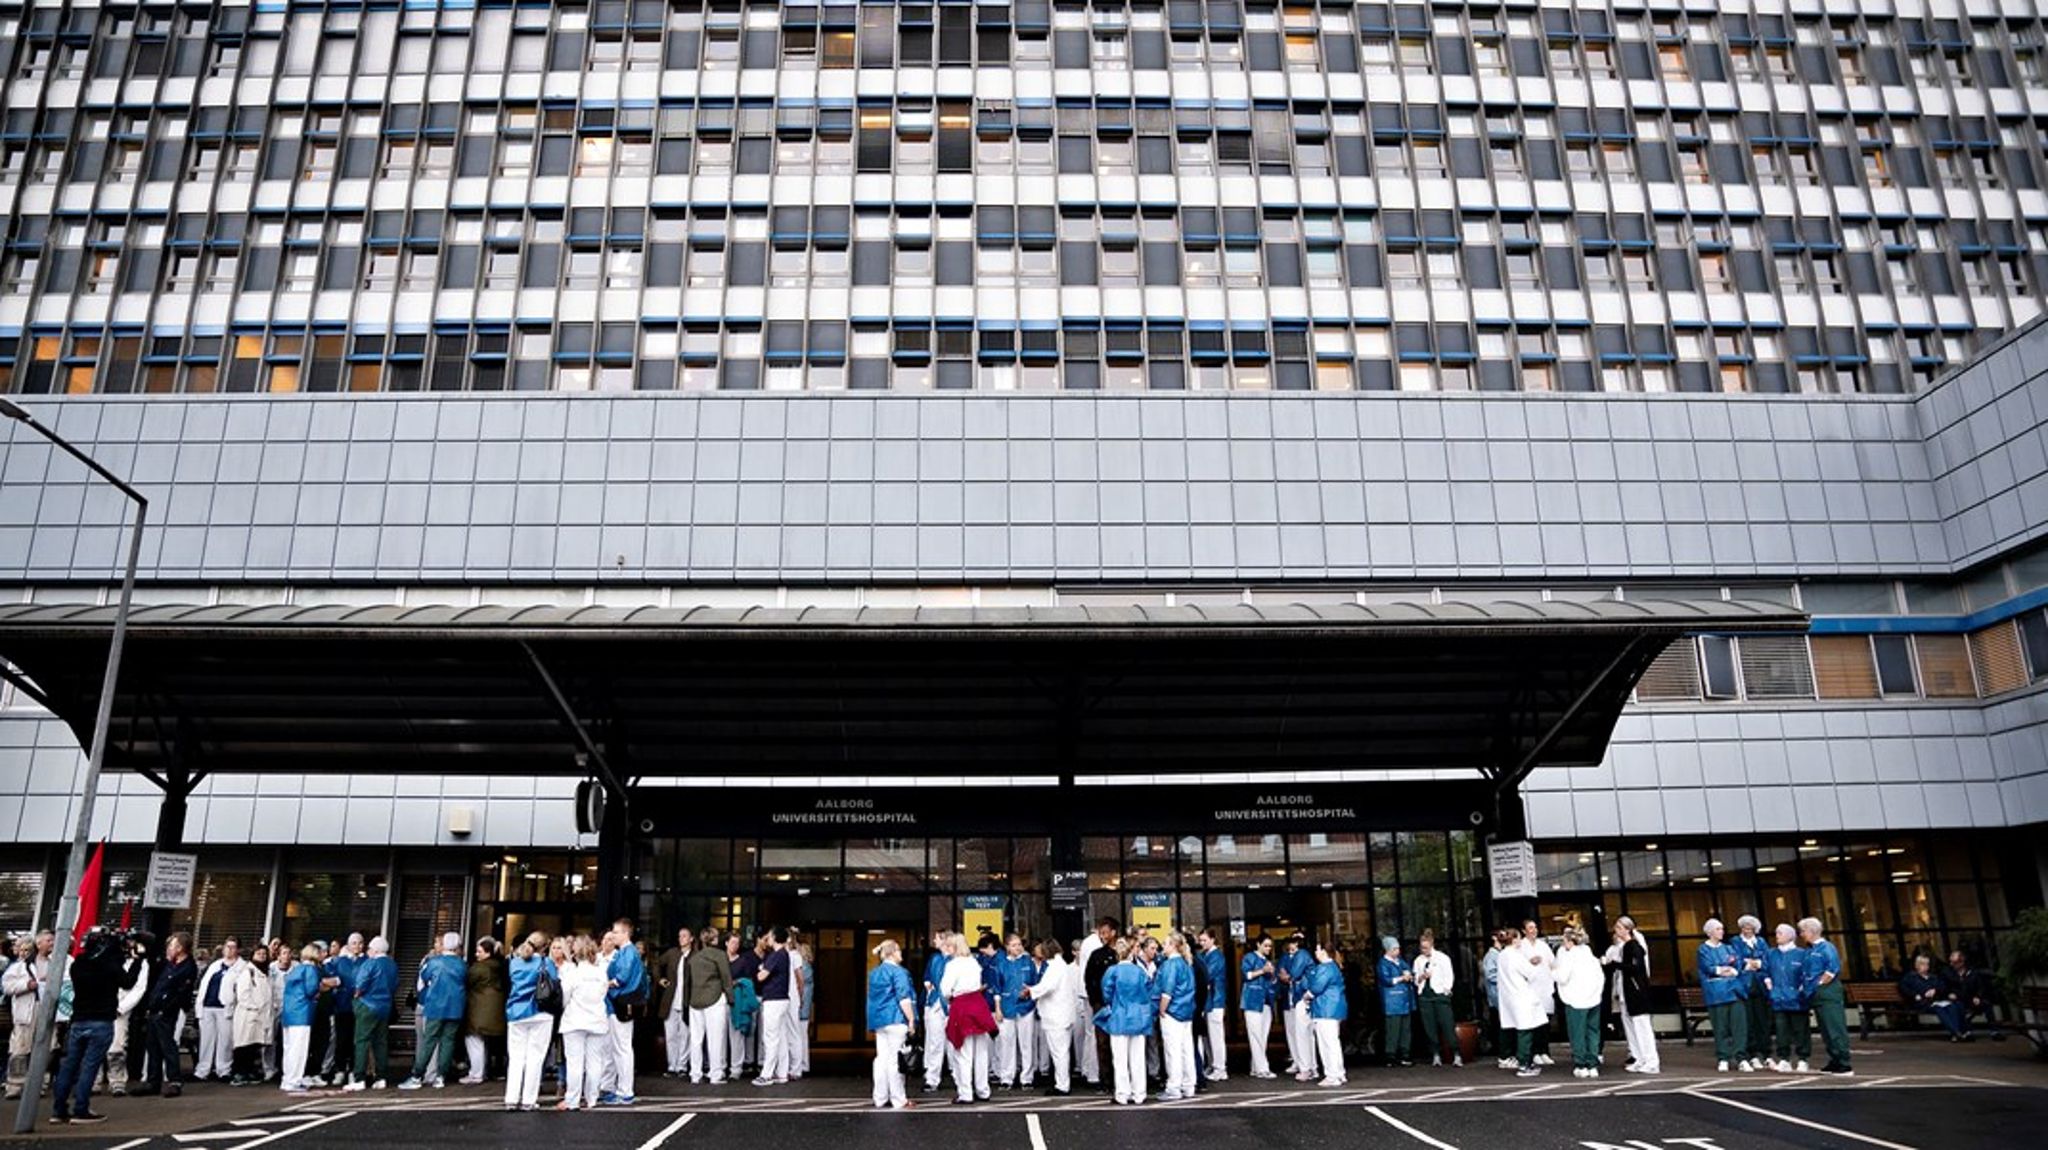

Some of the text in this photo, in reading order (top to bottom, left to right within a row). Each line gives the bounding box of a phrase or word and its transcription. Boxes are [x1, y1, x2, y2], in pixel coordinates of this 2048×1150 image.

[815, 799, 874, 809] AALBORG
[1256, 795, 1314, 805] AALBORG
[772, 812, 917, 824] UNIVERSITETSHOSPITAL
[1214, 808, 1356, 820] UNIVERSITETSHOSPITAL
[1053, 874, 1063, 885] P
[966, 895, 999, 903] COVID-19
[1134, 893, 1167, 901] COVID-19
